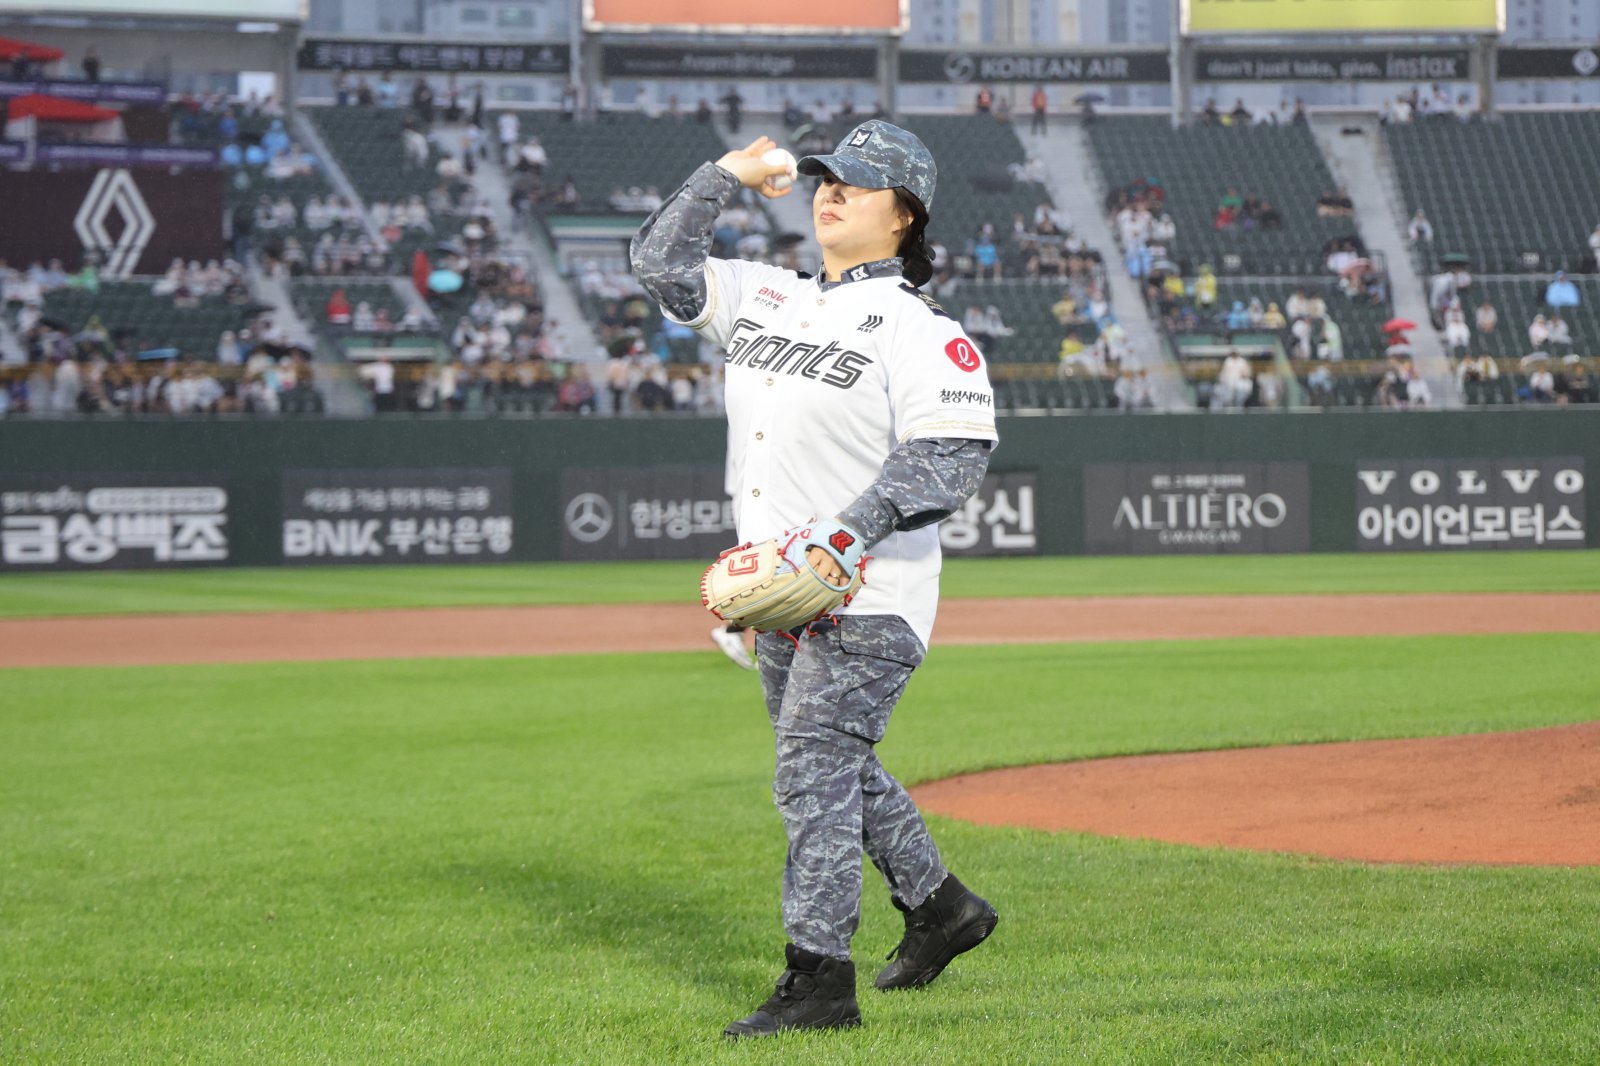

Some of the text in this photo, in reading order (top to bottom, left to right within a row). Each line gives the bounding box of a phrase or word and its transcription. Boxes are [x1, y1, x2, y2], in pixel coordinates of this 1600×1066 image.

[981, 57, 1129, 78] KOREAN AIR
[758, 286, 789, 304] BNK
[725, 317, 875, 390] Giants
[939, 388, 992, 407] 칠성사이다
[1358, 470, 1584, 496] VOLVO
[1, 513, 229, 563] 금성백조
[283, 518, 384, 557] BNK
[386, 516, 513, 554] 부산은행
[1358, 502, 1585, 546] 아이언모터스
